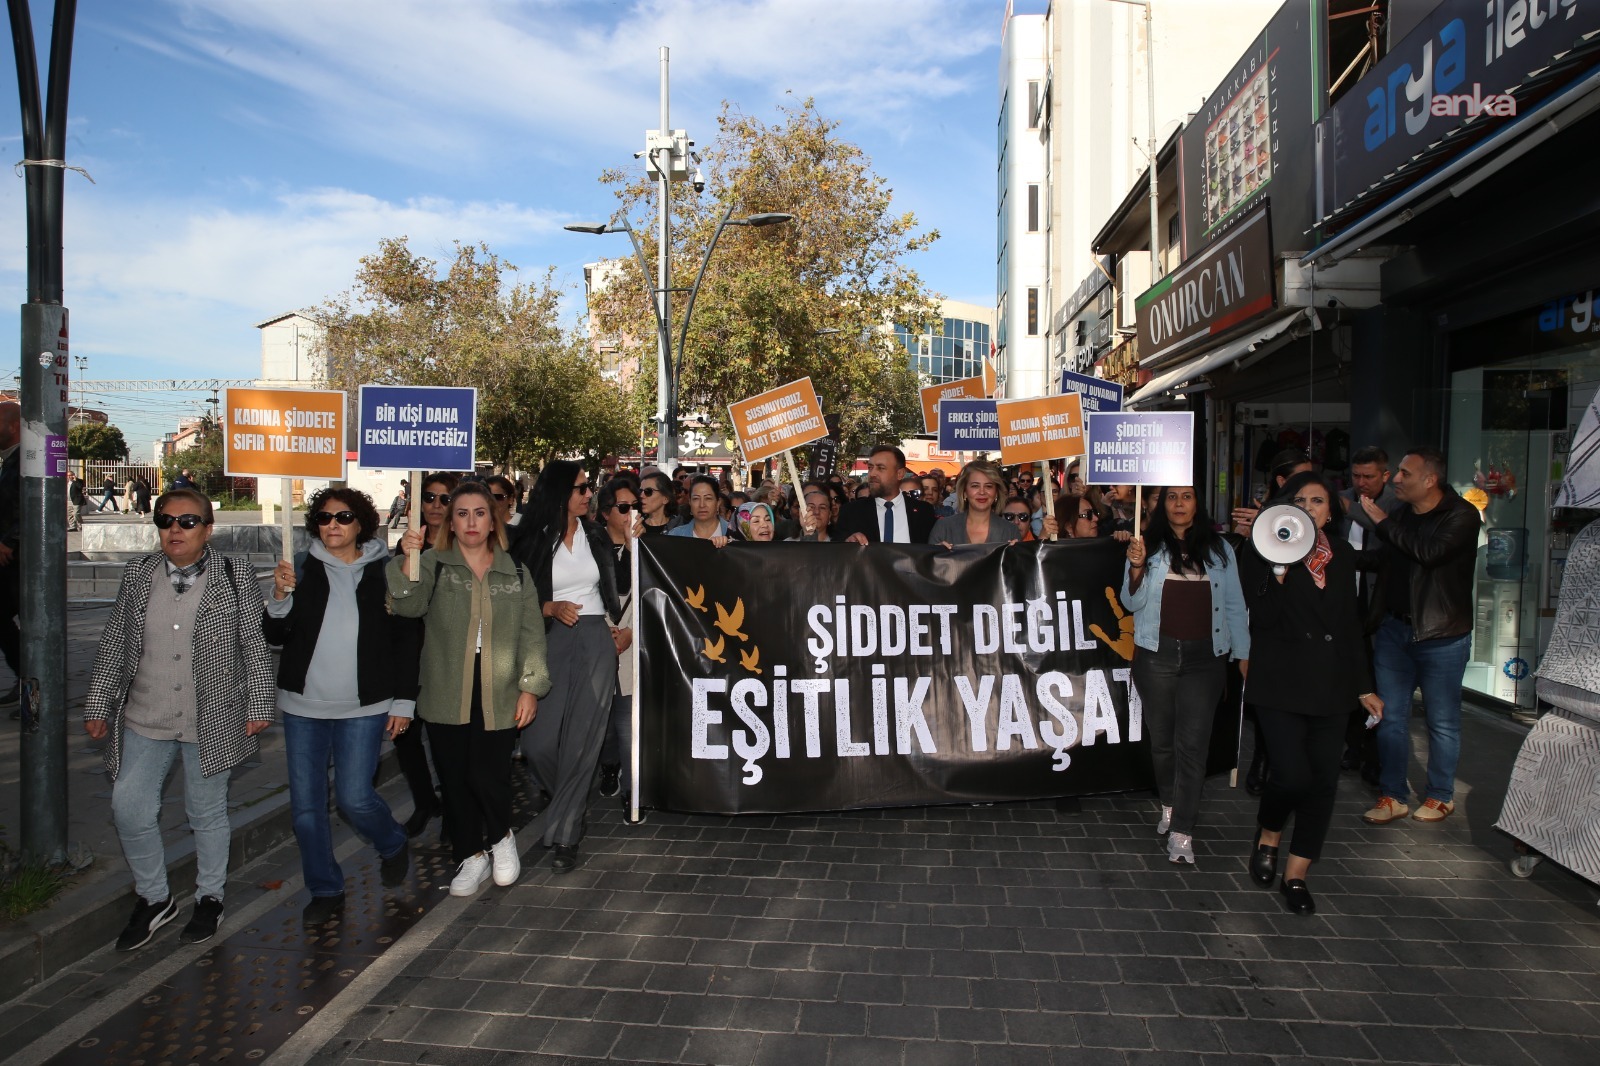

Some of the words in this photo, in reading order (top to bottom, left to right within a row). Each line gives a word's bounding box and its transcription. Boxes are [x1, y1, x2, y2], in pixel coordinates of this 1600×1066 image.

[1207, 49, 1262, 125] AYAKKABI
[1363, 17, 1466, 152] arya
[1149, 245, 1245, 345] ONURCAN
[1066, 379, 1088, 394] KORKU
[1089, 385, 1118, 402] DUVARINI
[375, 402, 396, 422] BİR
[399, 403, 423, 428] KİŞİ
[425, 407, 459, 424] DAHA
[744, 391, 802, 421] SUSMUYORUZ
[1082, 397, 1100, 411] DEĞİL
[234, 408, 281, 427] KADINA
[284, 406, 336, 432] ŞİDDETE
[746, 404, 810, 436] KORKMUYORUZ
[948, 412, 974, 423] ERKEK
[975, 410, 998, 425] ŞİDDE
[1010, 416, 1040, 431] KADINA
[1041, 412, 1069, 430] ŞİDDET
[365, 426, 468, 447] EKSİLMEYECEĞİZ!
[744, 435, 769, 452] İTAAT
[769, 416, 821, 443] ETMİYORUZ!
[954, 426, 999, 439] POLİTİKTİR!
[1002, 431, 1041, 448] TOPLUMU
[1042, 426, 1081, 442] YARALAR!
[1116, 421, 1164, 441] ŞİDDETİN
[233, 433, 265, 451] SIFIR
[268, 434, 336, 455] TOLERANS!
[695, 448, 714, 456] AVM
[1093, 438, 1145, 455] BAHANESİ
[1148, 441, 1186, 455] OLMAZ
[1094, 456, 1139, 473] FAİLLERİ
[807, 594, 958, 674] ŞİDDET
[972, 590, 1098, 655] DEĞİL
[691, 663, 938, 786] EŞİTLİK
